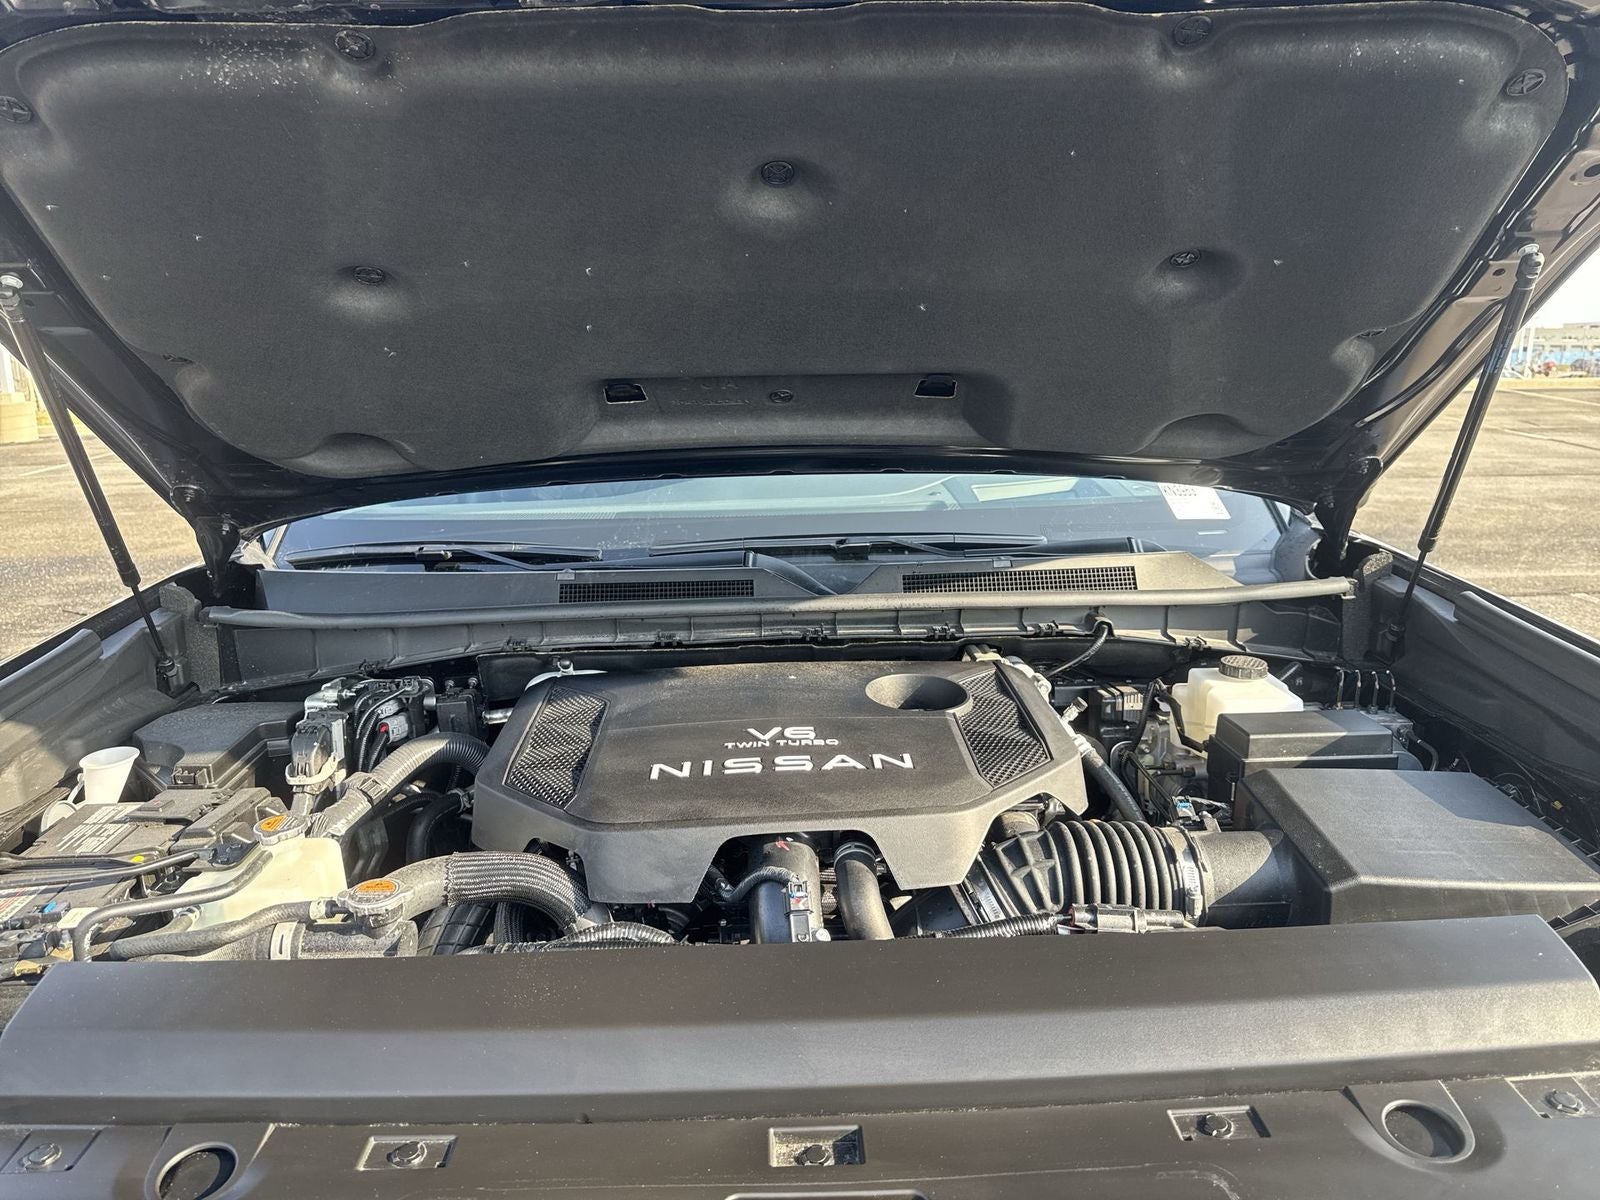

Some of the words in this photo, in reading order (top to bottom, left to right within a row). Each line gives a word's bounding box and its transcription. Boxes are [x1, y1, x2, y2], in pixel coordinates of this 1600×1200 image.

[746, 726, 816, 740] V6
[724, 740, 770, 749] TWIN
[776, 738, 839, 746] TURBO
[650, 753, 914, 780] NISSAN
